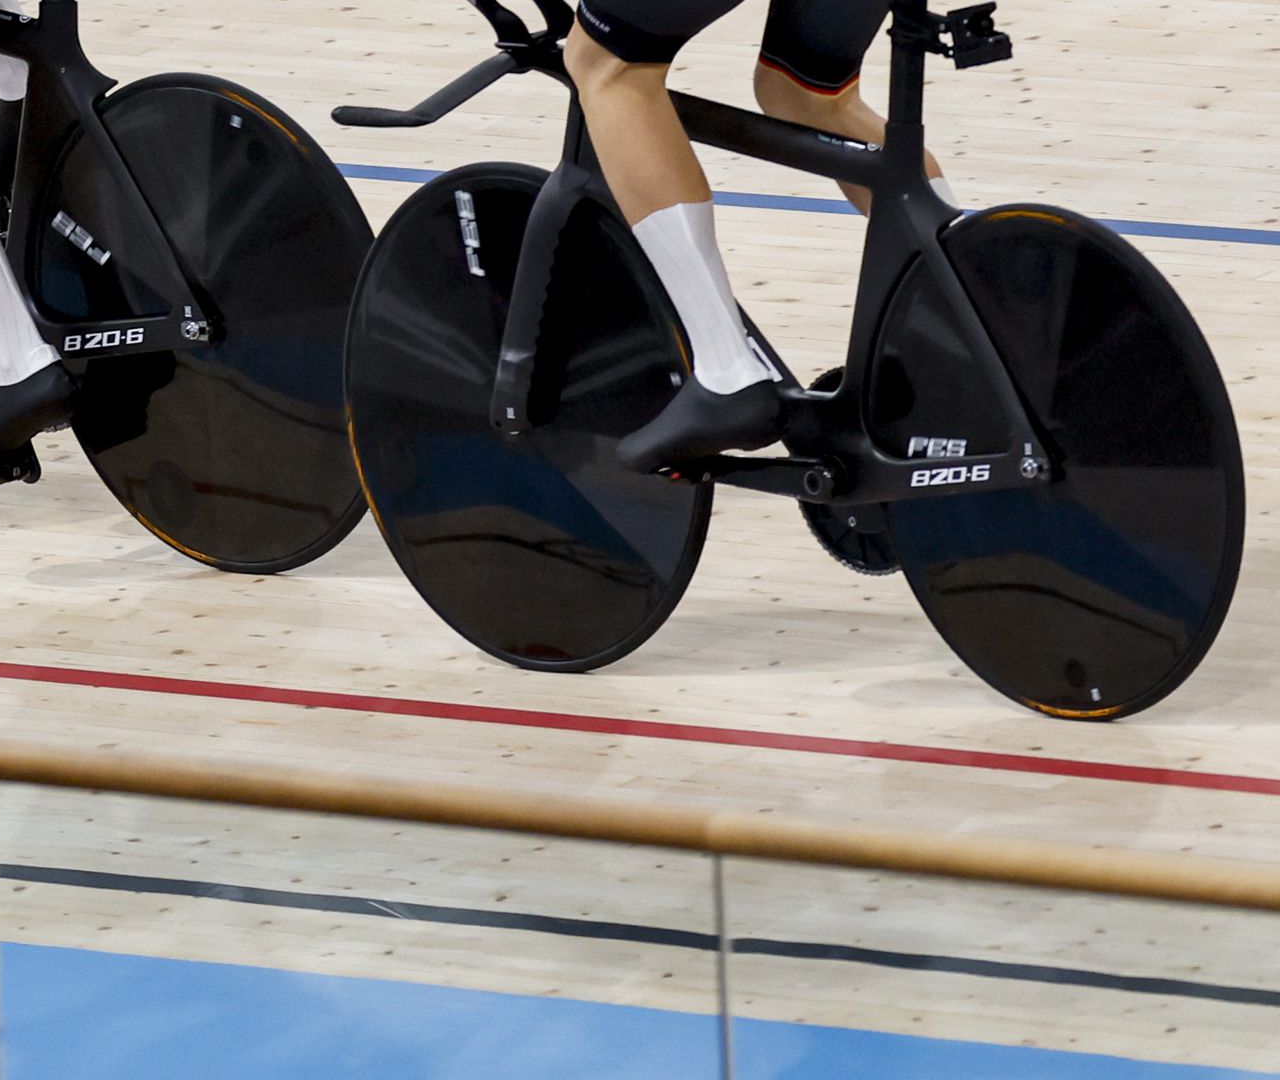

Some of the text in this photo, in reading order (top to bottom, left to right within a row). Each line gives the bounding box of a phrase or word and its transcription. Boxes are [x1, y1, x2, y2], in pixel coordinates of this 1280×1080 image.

[50, 209, 112, 266] FES
[454, 189, 486, 277] FES
[907, 435, 968, 458] FES
